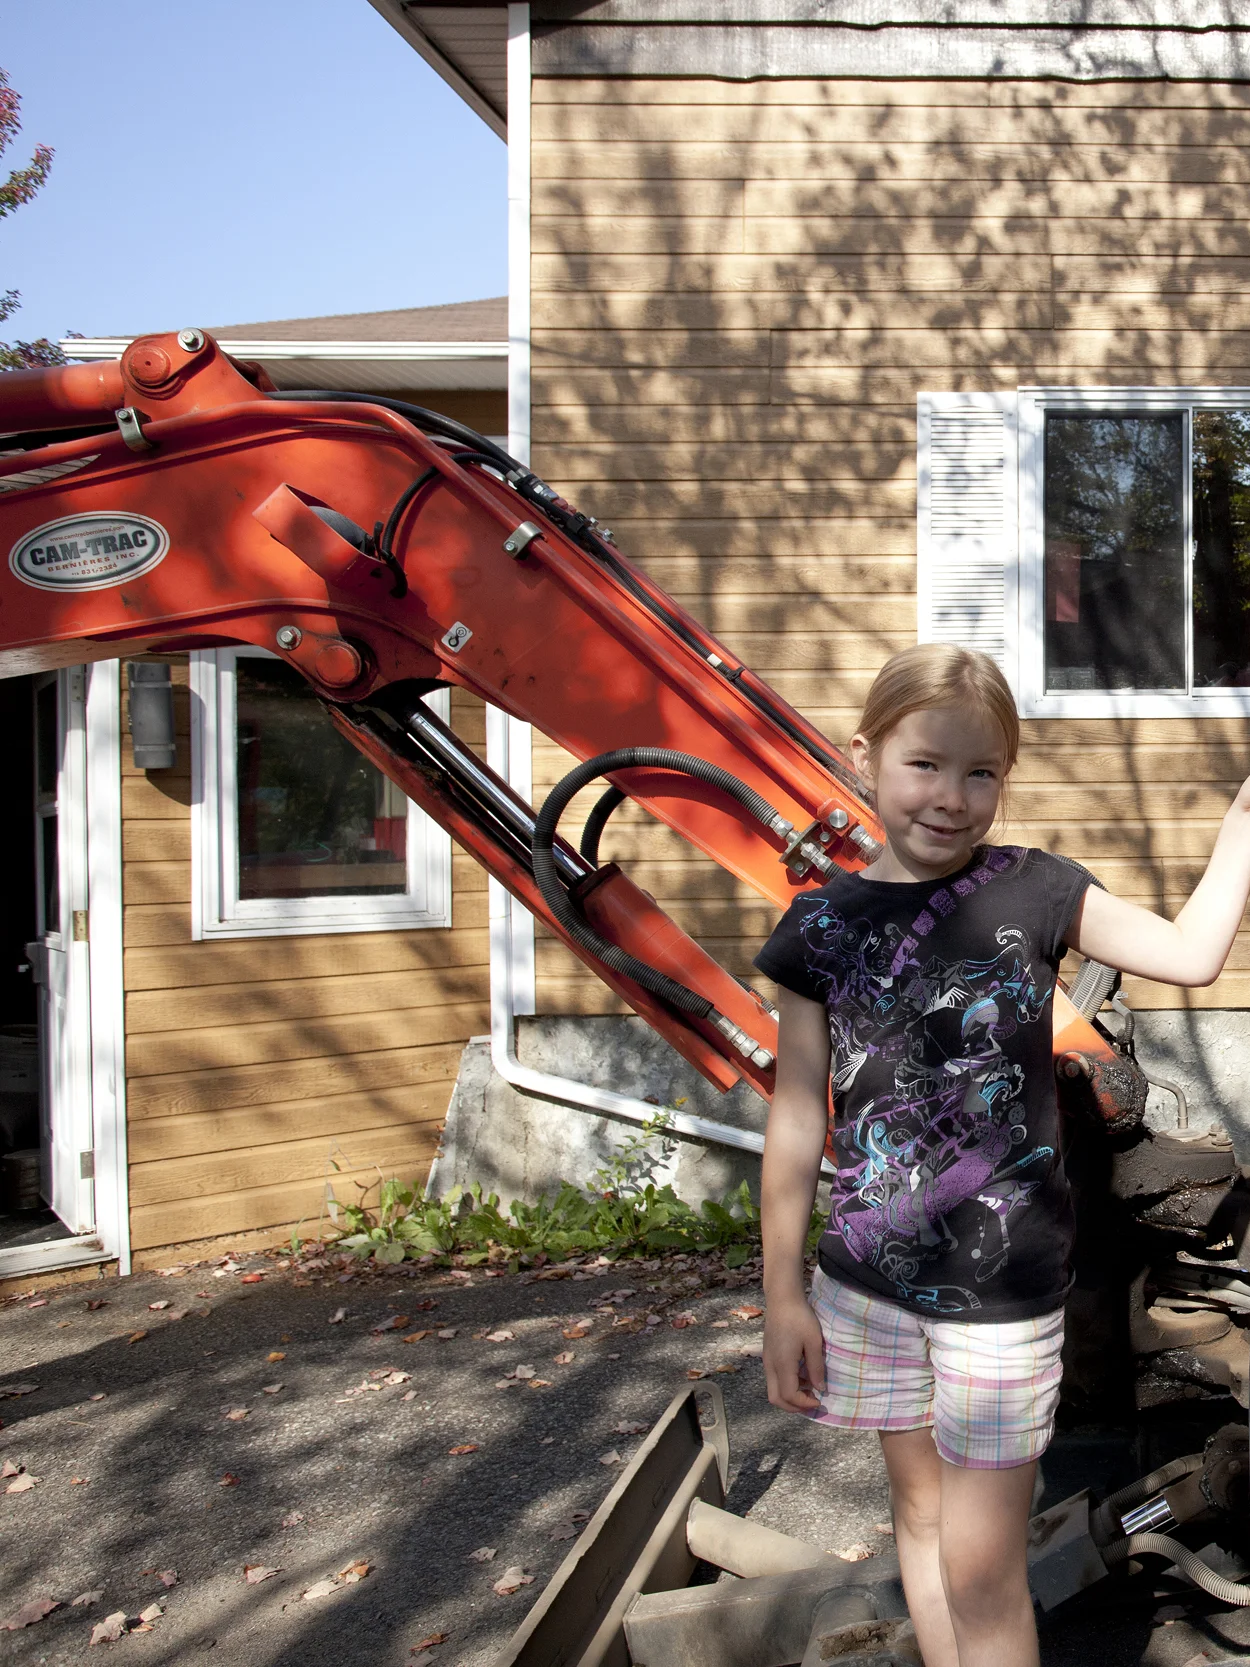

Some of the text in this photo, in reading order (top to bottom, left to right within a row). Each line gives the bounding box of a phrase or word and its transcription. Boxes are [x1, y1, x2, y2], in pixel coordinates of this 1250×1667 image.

[30, 530, 148, 566] CAM-TRAC
[47, 551, 140, 573] BERNIÈRES INC.
